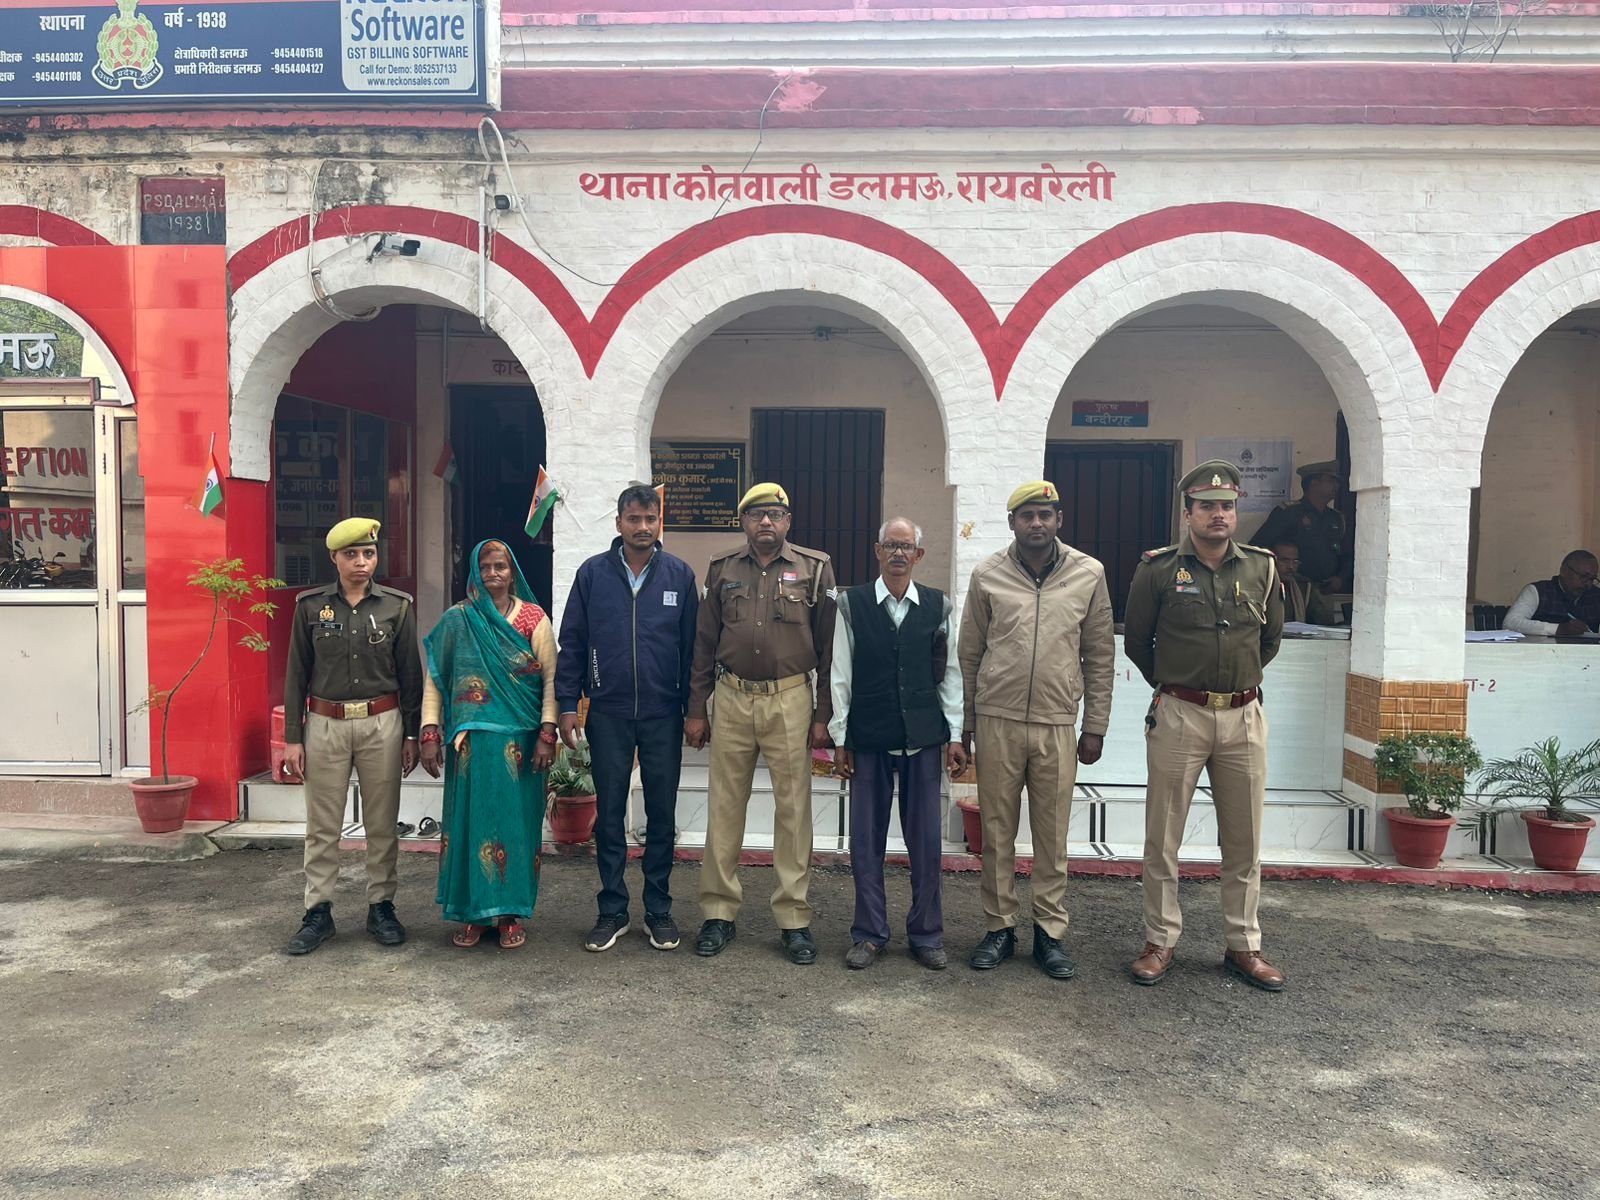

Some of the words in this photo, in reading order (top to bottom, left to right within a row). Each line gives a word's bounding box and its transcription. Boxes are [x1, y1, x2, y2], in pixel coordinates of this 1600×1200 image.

[39, 14, 86, 31] स्थापना
[164, 7, 184, 28] वर्ष
[196, 11, 227, 29] 1938
[350, 6, 465, 42] Software
[219, 48, 248, 59] डलमऊ
[347, 47, 368, 59] GST
[370, 46, 409, 59] BILLING
[412, 46, 469, 59] SOFTWARE
[174, 63, 198, 75] प्रभारी
[198, 62, 233, 75] निरीक्षक
[233, 64, 262, 75] डलमऊ
[359, 64, 374, 74] Call
[375, 64, 387, 74] for
[388, 64, 412, 74] Demo:
[413, 64, 457, 74] 8052537133
[367, 77, 450, 87] www.reckonsales.com
[579, 171, 671, 201] थाना
[673, 163, 822, 203] कोतवाली
[956, 161, 1117, 203] रायबरेली
